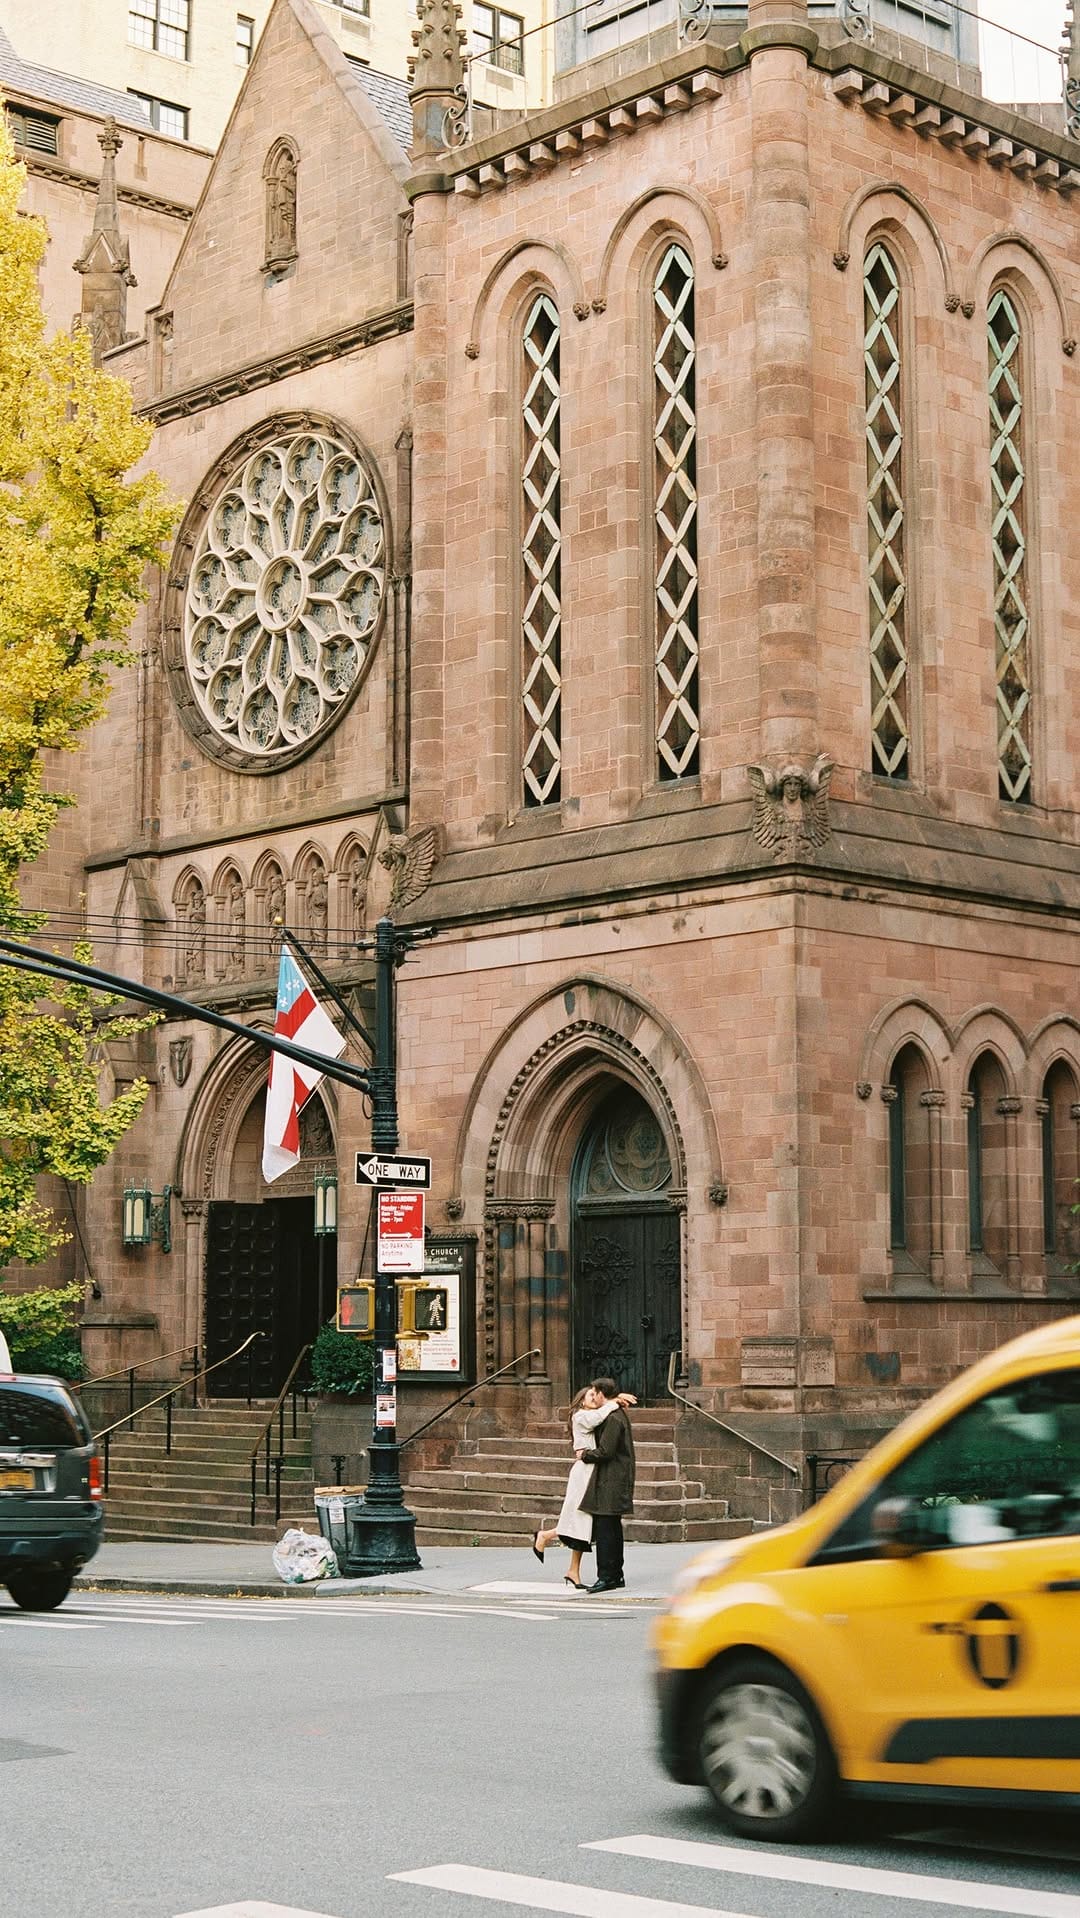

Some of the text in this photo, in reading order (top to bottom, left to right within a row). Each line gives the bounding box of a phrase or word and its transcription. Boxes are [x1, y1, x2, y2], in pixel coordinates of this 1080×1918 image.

[368, 1164, 421, 1178] ONE WAY
[430, 1247, 459, 1256] CHURCH
